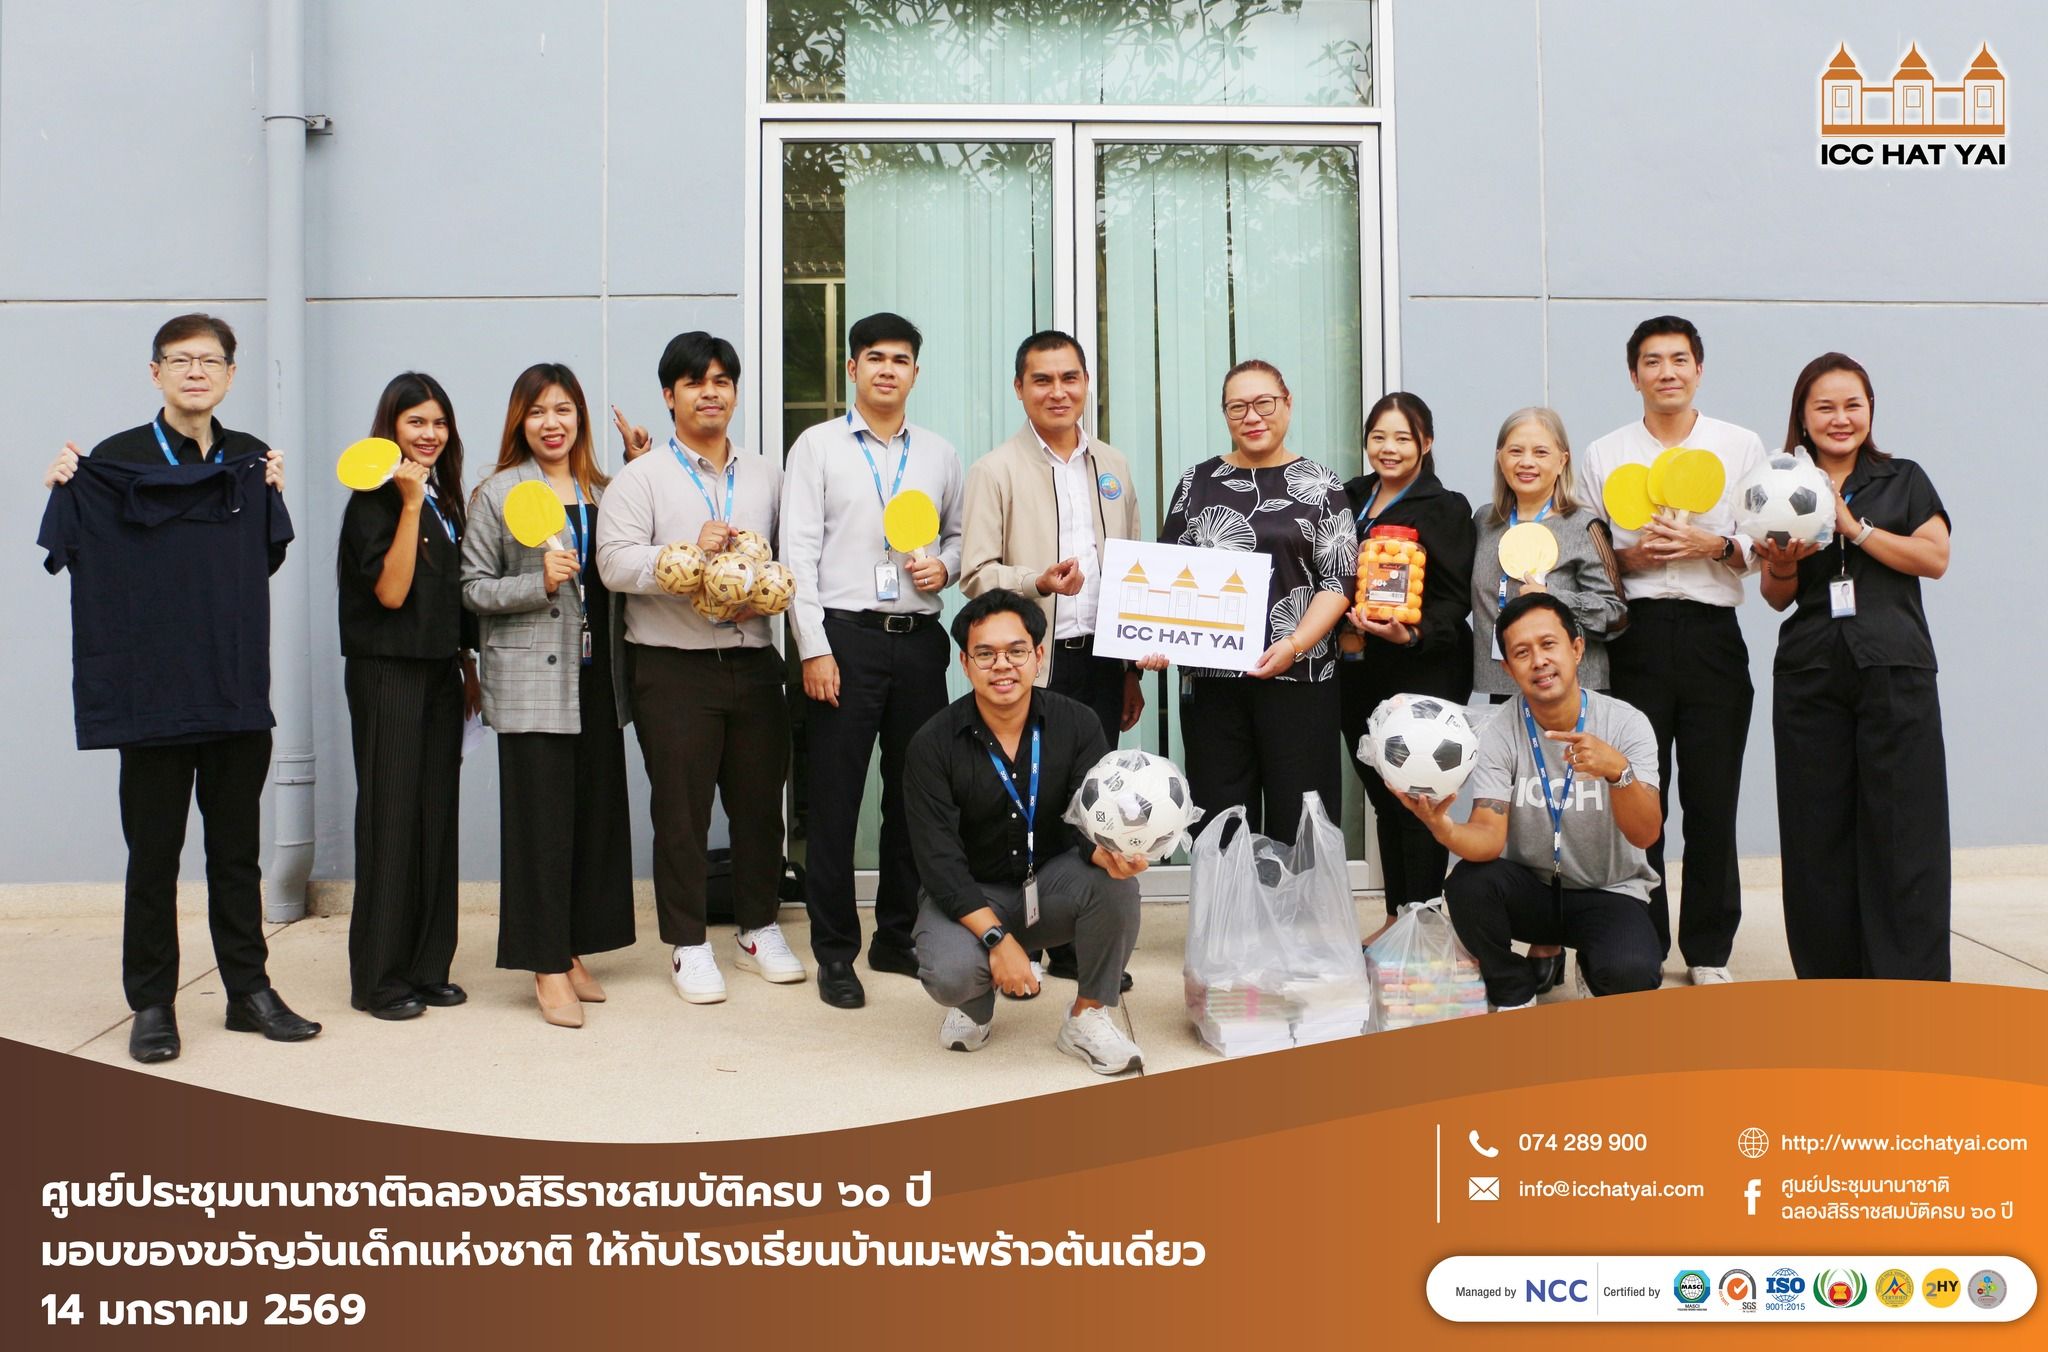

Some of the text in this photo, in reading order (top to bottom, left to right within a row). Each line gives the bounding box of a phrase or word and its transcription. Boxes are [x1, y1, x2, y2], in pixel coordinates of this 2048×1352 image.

[1117, 624, 1244, 651] ICC HAT YAI
[1515, 776, 1604, 812] ICCH
